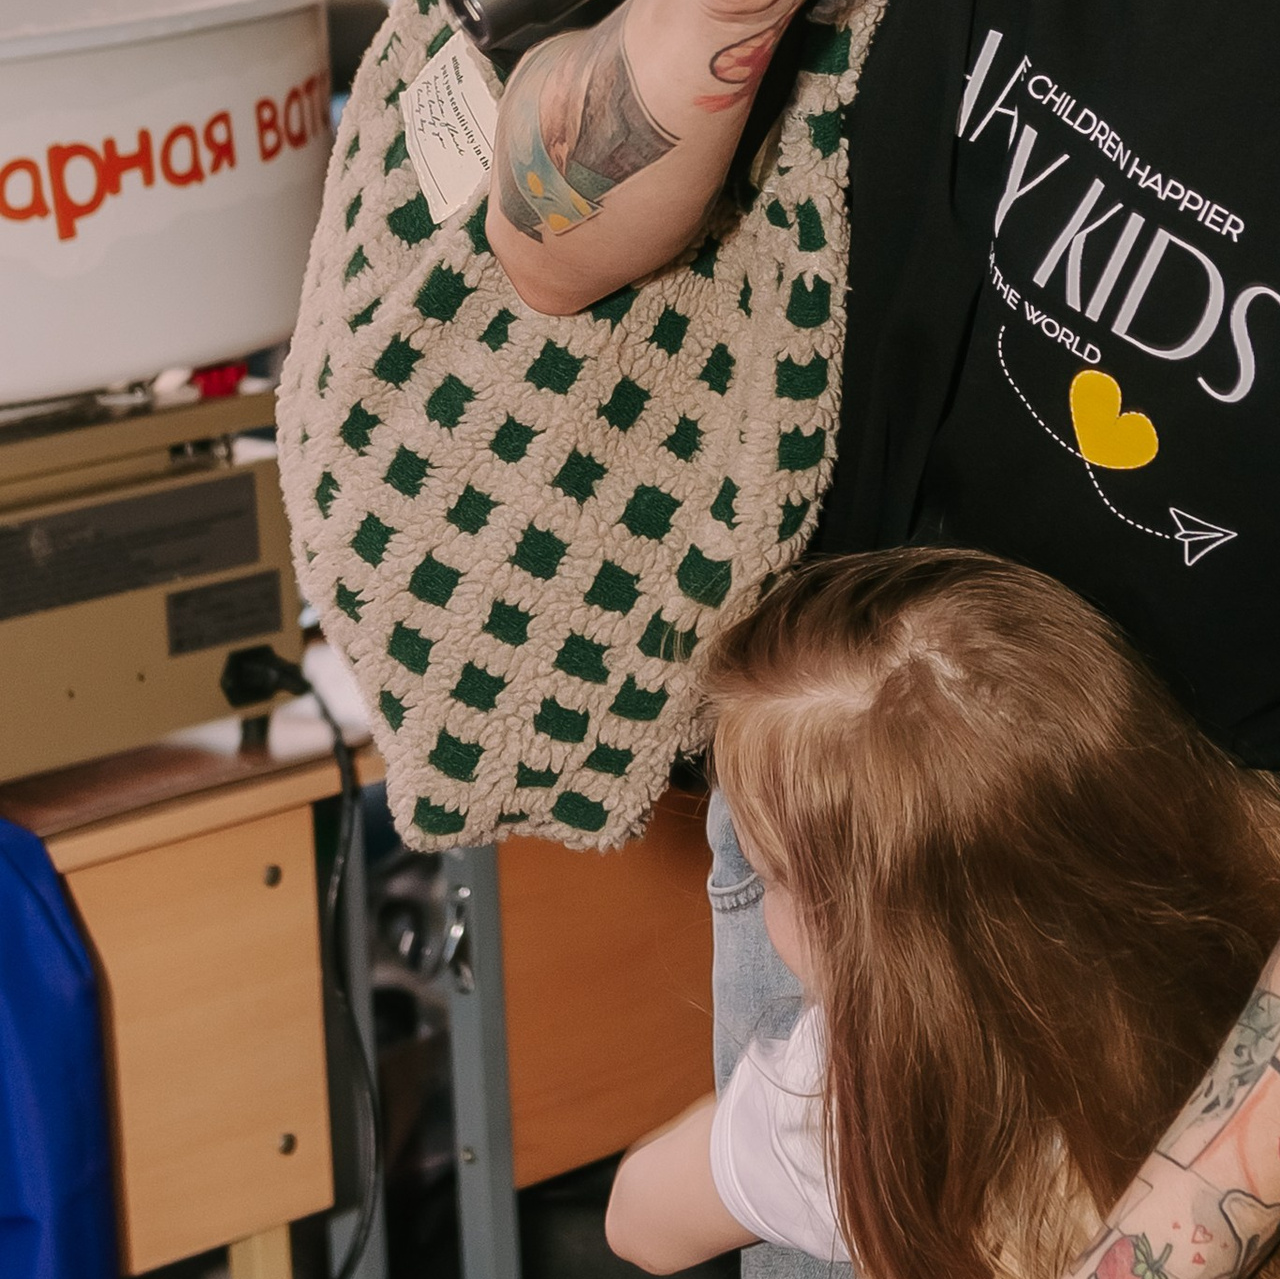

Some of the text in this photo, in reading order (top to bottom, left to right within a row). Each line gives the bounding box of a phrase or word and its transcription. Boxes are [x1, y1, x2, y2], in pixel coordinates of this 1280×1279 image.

[443, 79, 453, 97] you
[450, 96, 476, 145] sensitivity
[473, 144, 483, 156] in
[1027, 74, 1246, 243] CHILDREN HAPPIER
[990, 265, 1102, 366] THE WORLD
